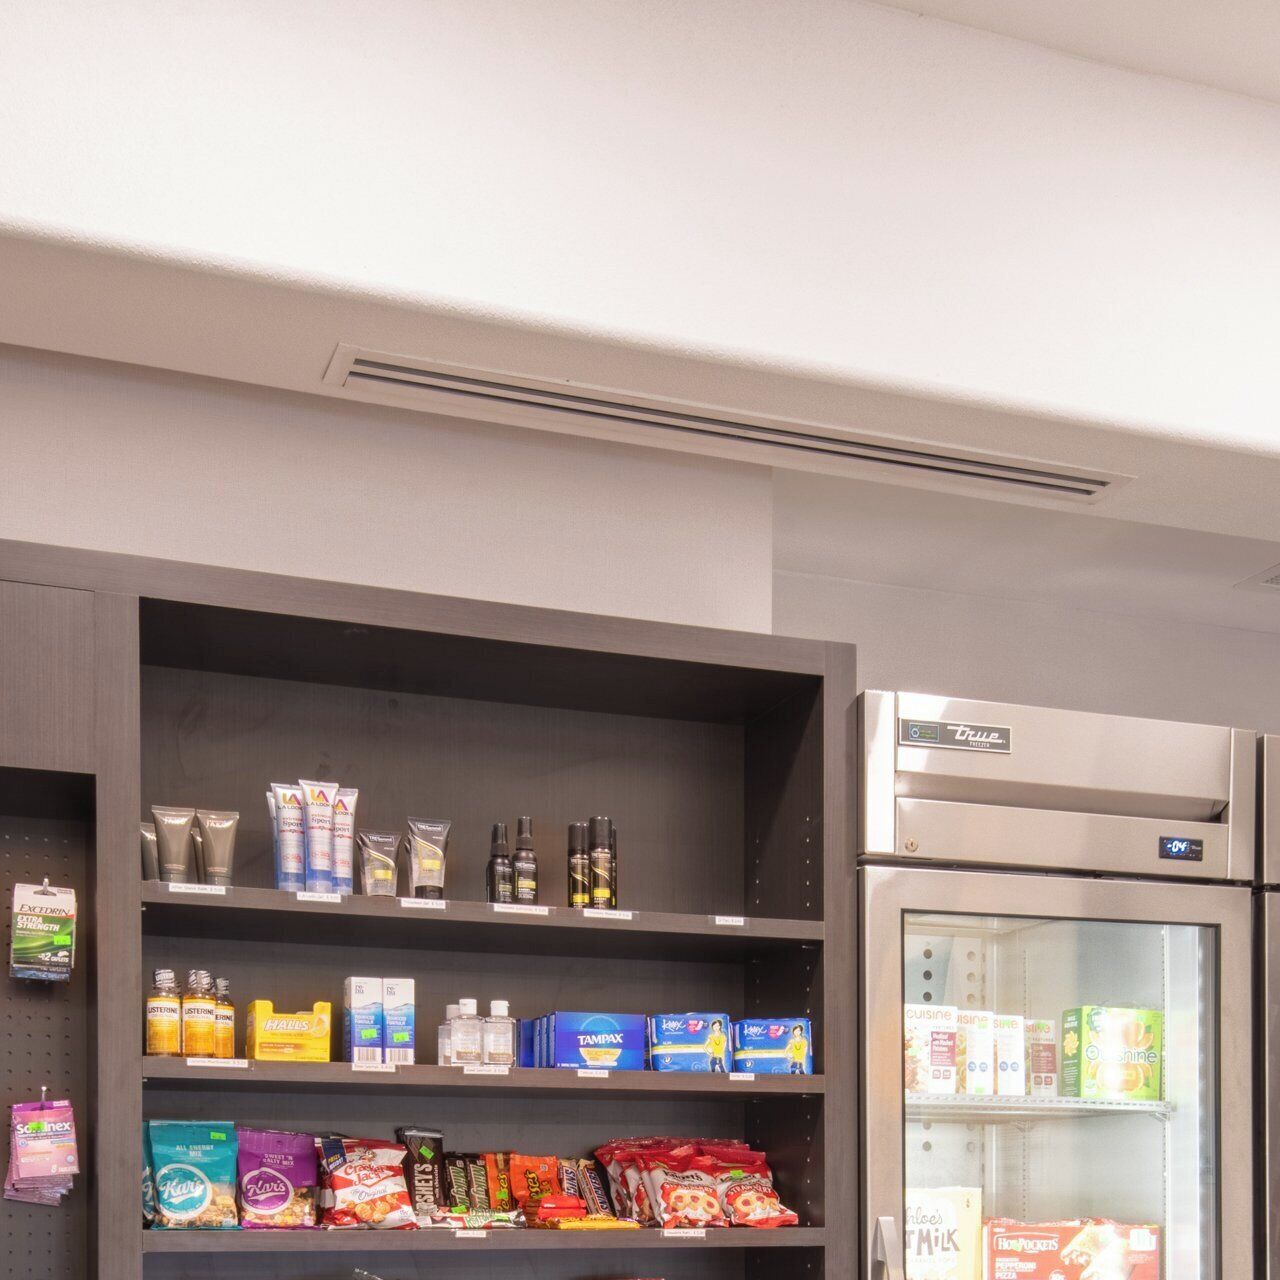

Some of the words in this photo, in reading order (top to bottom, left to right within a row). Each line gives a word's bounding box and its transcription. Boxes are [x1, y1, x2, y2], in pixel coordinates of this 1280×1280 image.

[311, 817, 330, 826] Sport
[20, 903, 71, 916] EXCEDRIN
[17, 915, 43, 924] EXTRA
[16, 922, 60, 932] STRENGTH
[148, 1007, 178, 1015] LISTERINE
[185, 1008, 215, 1016] LISTERINE
[907, 1009, 952, 1021] cuisine
[265, 1019, 309, 1032] HALLS
[577, 1033, 623, 1046] TAMPAX
[344, 1164, 386, 1177] Cracker
[246, 1180, 286, 1197] Kar's
